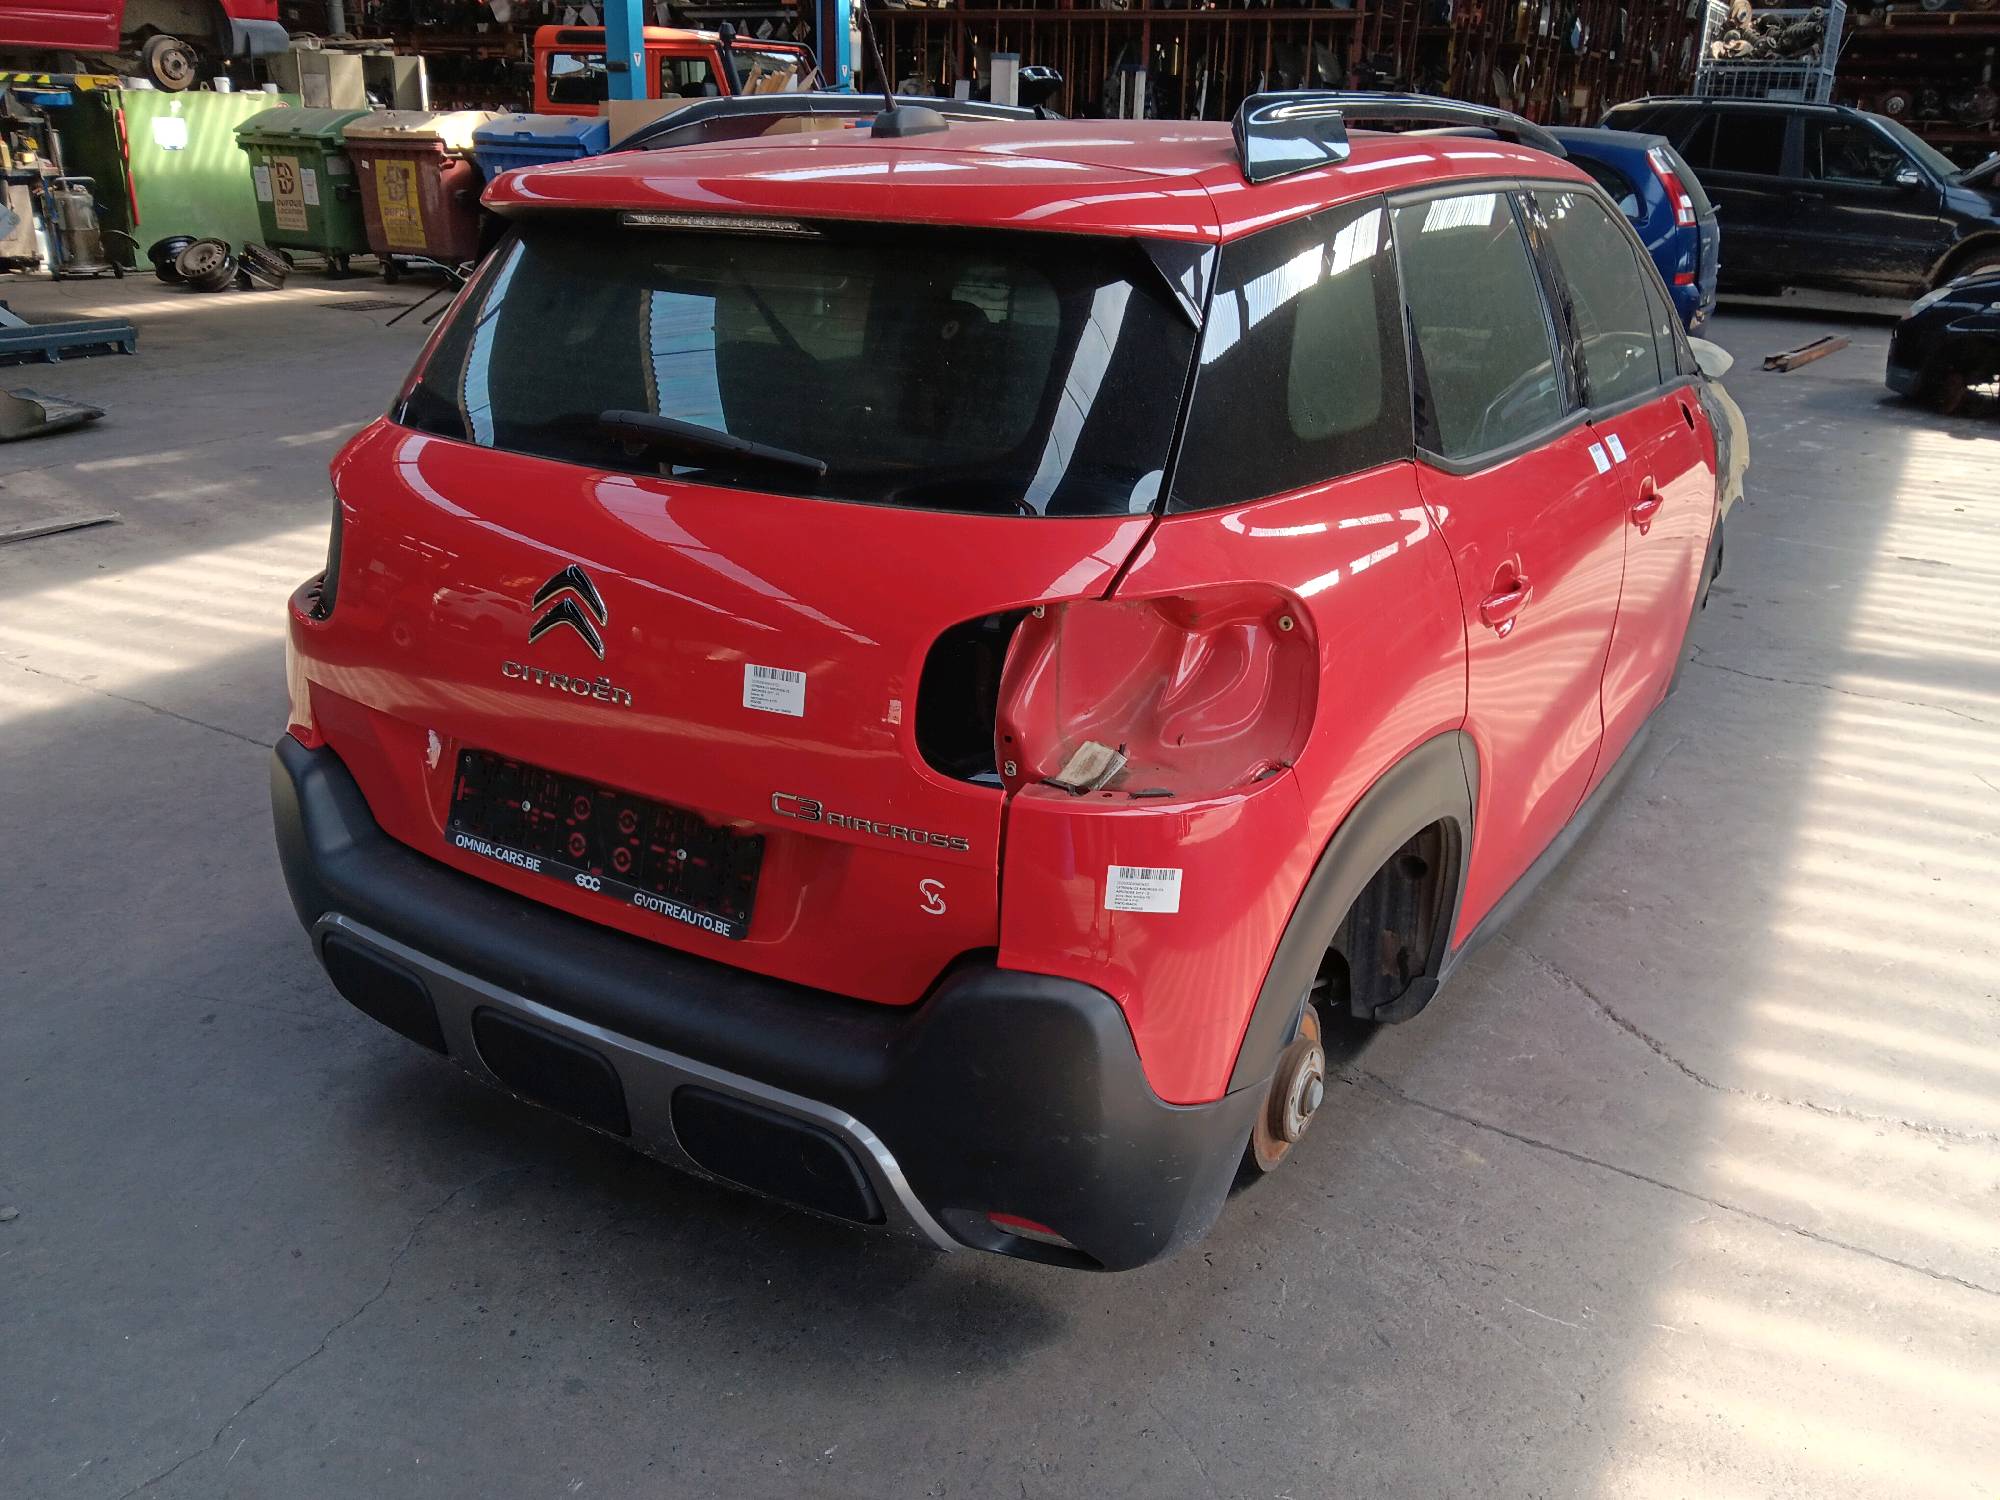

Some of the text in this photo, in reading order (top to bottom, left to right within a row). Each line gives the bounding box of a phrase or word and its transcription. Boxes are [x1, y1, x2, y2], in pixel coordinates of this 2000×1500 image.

[771, 791, 970, 851] C3 AIRCROSS
[455, 834, 541, 872] OMNIA-CARS.BE
[634, 892, 731, 937] GVOTREAUTO.BE
